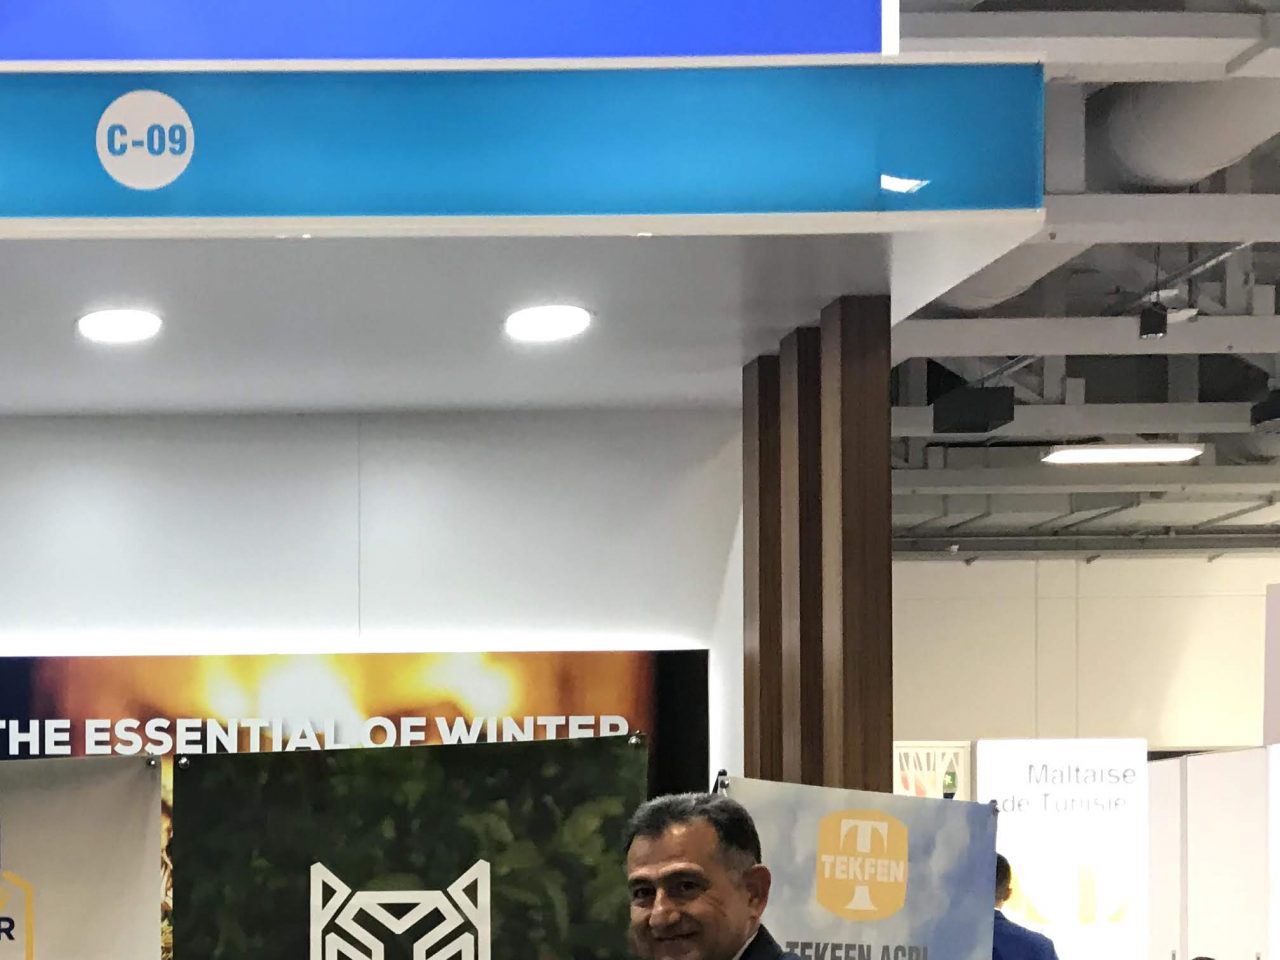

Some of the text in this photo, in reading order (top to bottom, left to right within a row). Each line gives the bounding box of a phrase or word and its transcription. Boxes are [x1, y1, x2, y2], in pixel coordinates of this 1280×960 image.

[106, 125, 188, 157] C-09
[84, 717, 351, 757] ESSENTIAL
[361, 715, 427, 749] OF
[1028, 764, 1136, 785] Maltaise
[821, 854, 905, 882] TEKFEN
